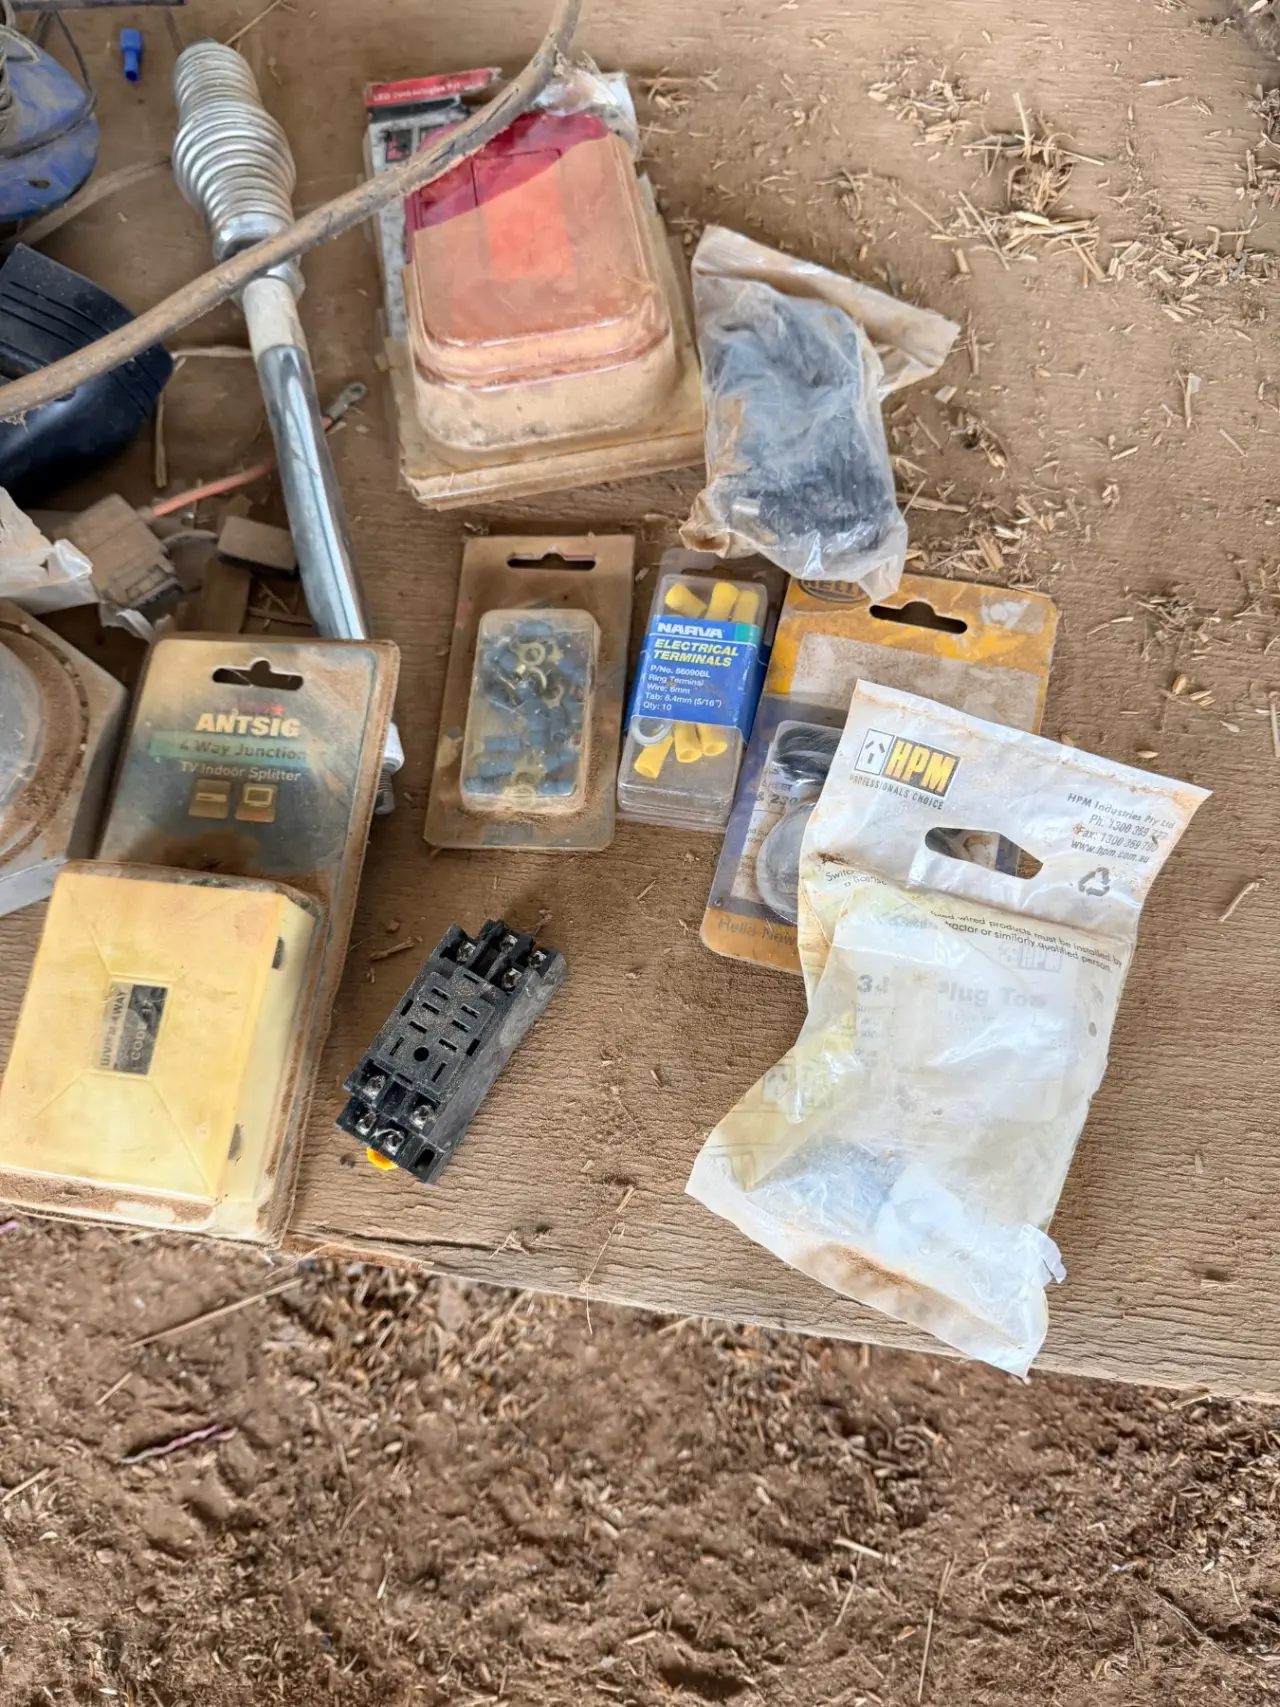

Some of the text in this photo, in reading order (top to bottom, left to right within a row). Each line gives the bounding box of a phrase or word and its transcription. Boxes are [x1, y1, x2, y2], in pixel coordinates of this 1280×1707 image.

[657, 622, 723, 638] NARVA
[655, 639, 739, 656] ELECTRICAL
[653, 649, 732, 667] TERMINALS
[650, 664, 674, 674] P/No.
[647, 682, 690, 695] Wire: 6mm
[648, 674, 704, 687] Ring Terminal
[645, 691, 664, 701] Tab:
[643, 701, 672, 711] Qty: 10
[195, 712, 301, 738] ANTSIG
[180, 760, 302, 782] TV Indoor Splitter
[884, 740, 956, 793] HPM
[849, 774, 945, 811] PROFESSIONALS CHOICE
[1067, 792, 1093, 808] HPM
[1094, 801, 1142, 821] Industries
[1108, 819, 1132, 834] 1300
[1100, 832, 1124, 847] 1300
[718, 917, 797, 946] Hella New
[980, 928, 992, 937] or
[994, 930, 1035, 948] similarly
[1038, 942, 1079, 960] qualified
[1081, 954, 1113, 974] person.
[989, 920, 1032, 937] products
[1034, 932, 1057, 943] must
[1058, 936, 1072, 949] be
[1112, 955, 1123, 969] by
